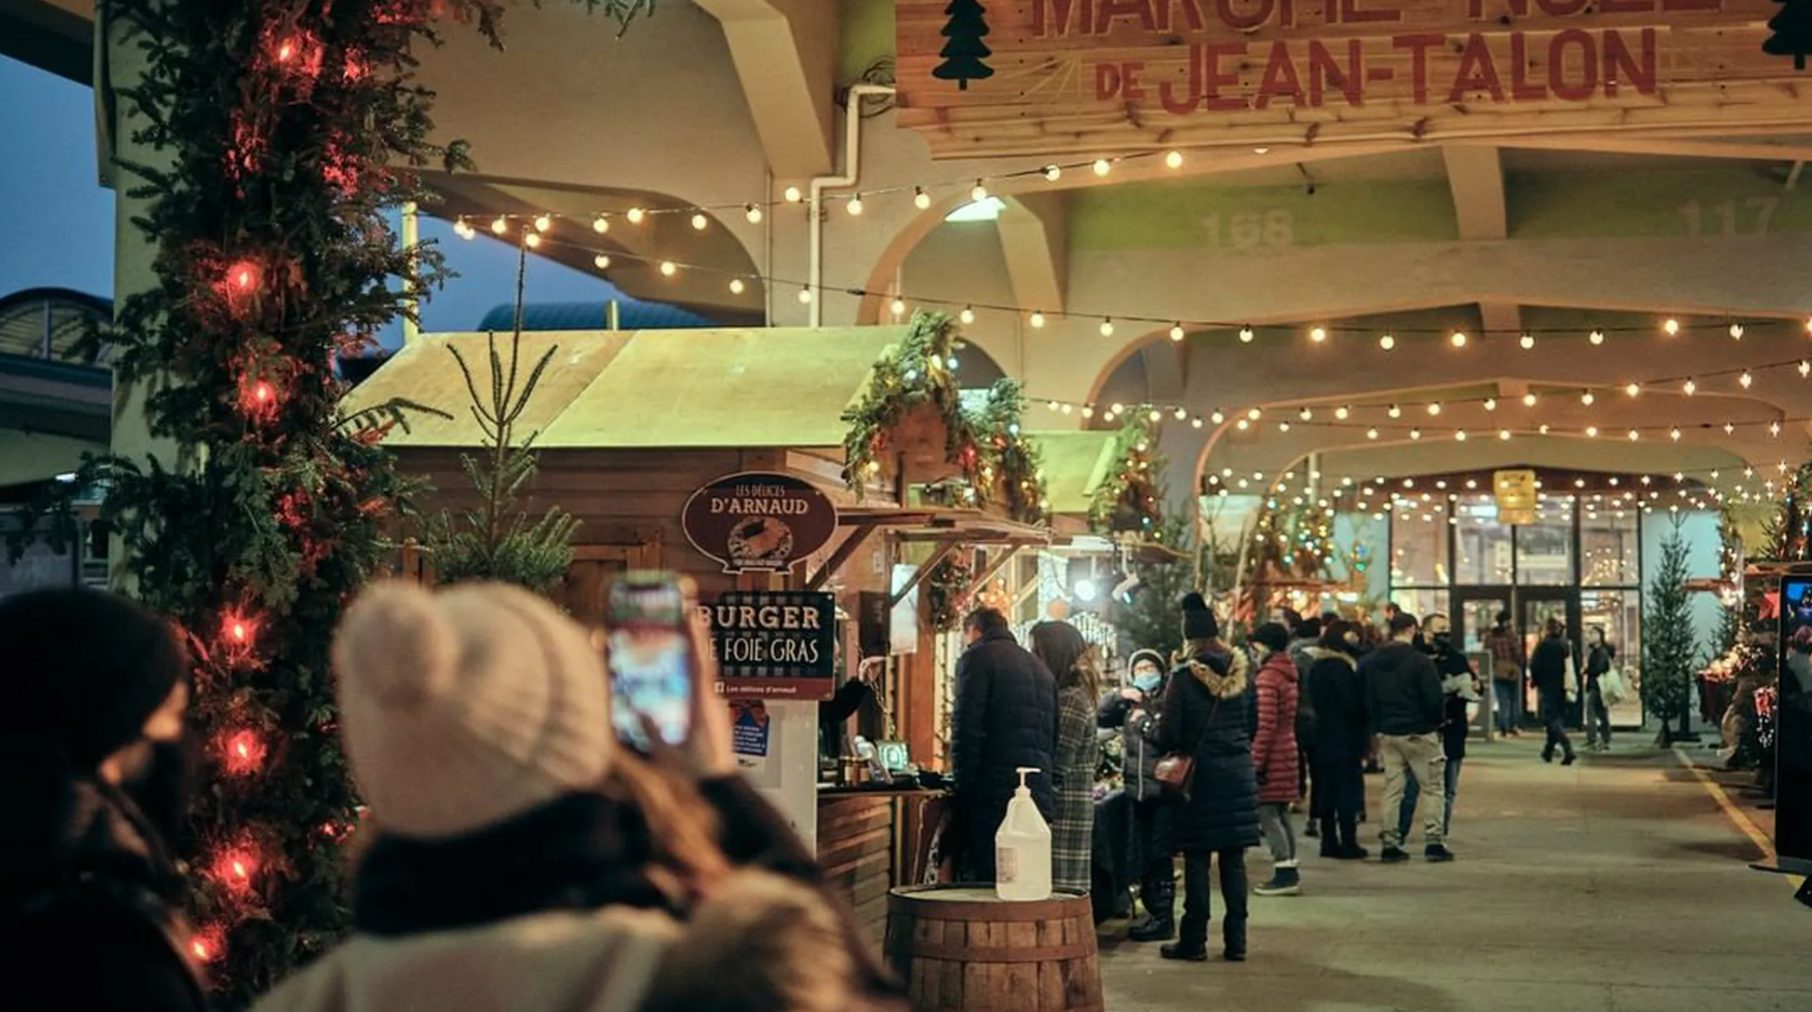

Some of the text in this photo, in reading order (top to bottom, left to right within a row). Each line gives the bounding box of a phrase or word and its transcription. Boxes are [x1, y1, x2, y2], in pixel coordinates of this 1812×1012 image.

[1095, 28, 1656, 115] DE JEAN-TALON
[1200, 208, 1294, 248] 168
[1678, 195, 1779, 241] 117
[735, 484, 750, 497] LES
[711, 497, 809, 514] D'ARNAUD
[697, 605, 820, 629] BURGER
[724, 637, 763, 661] FOIE
[770, 638, 819, 663] GRAS
